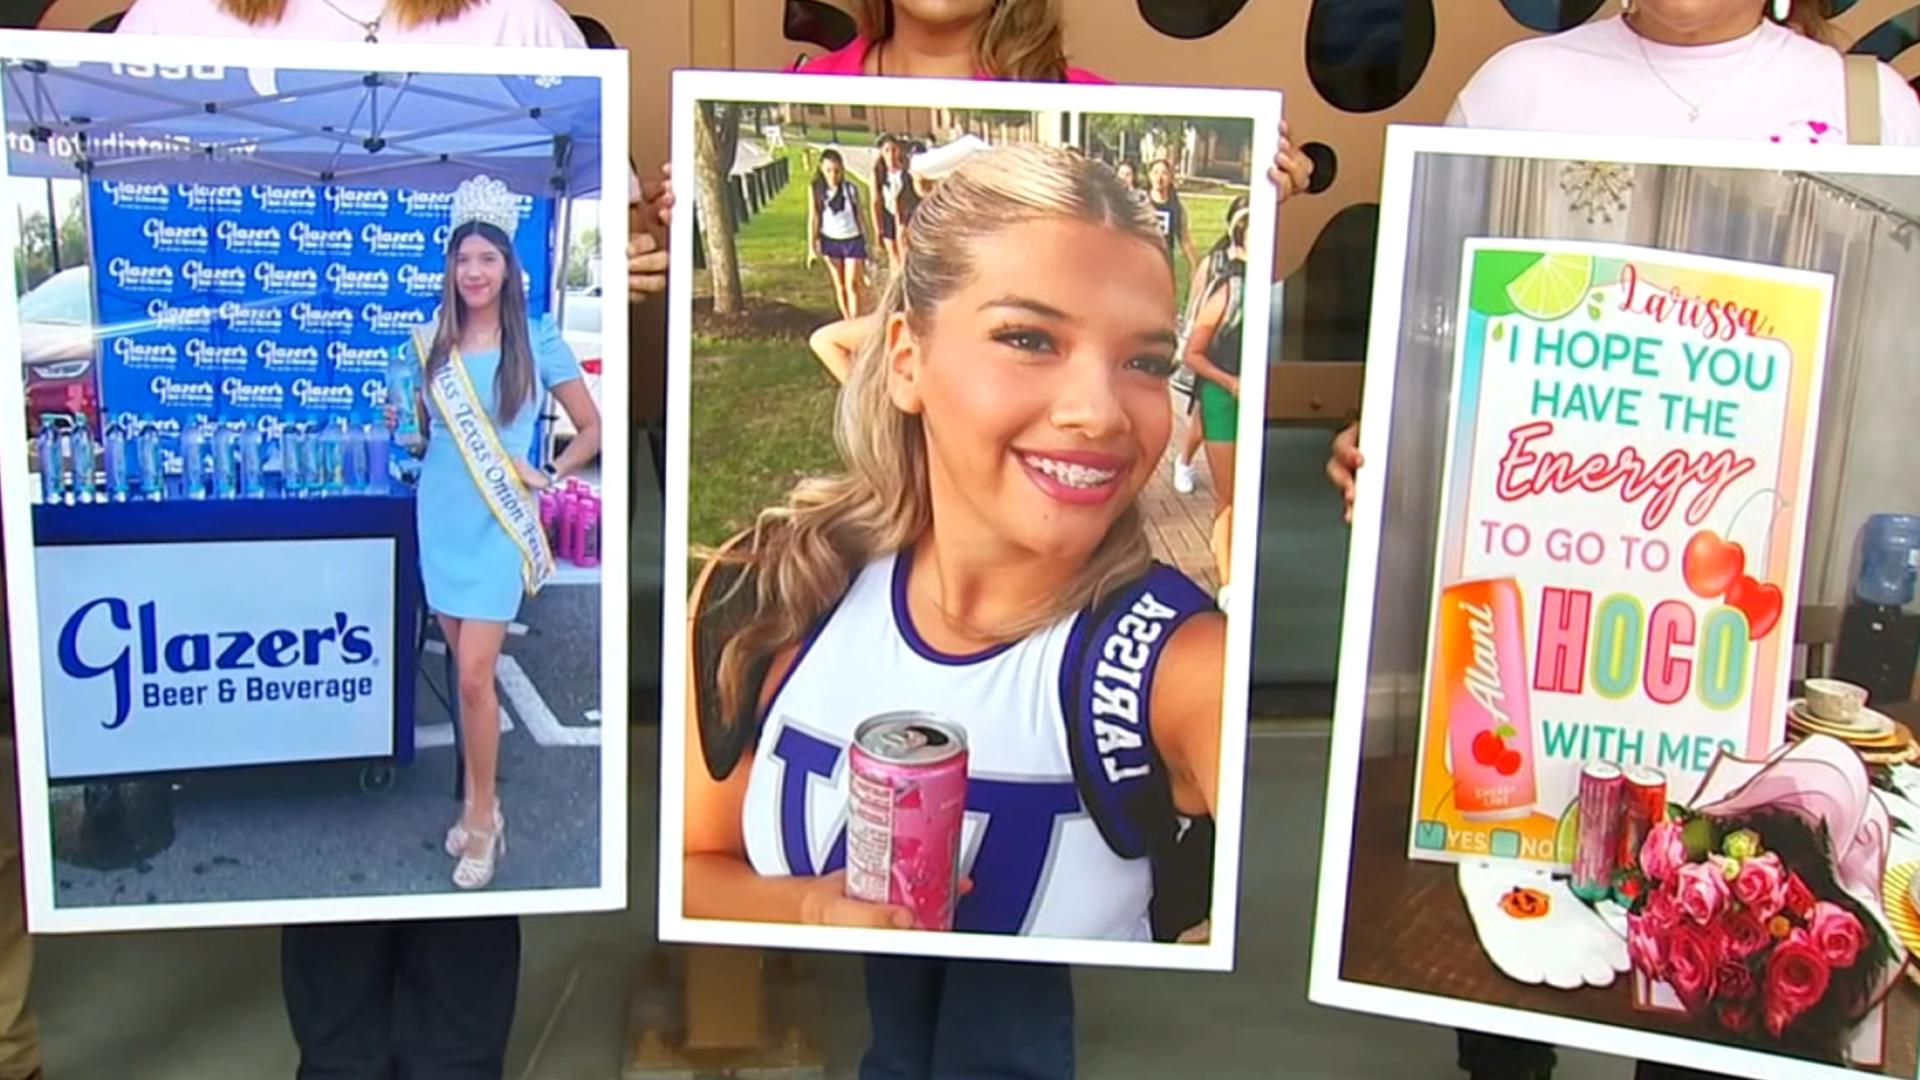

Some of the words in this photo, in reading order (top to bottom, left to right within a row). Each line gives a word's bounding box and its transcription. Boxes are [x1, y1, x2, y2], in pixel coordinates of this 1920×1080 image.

[1618, 263, 1775, 342] Larissa,
[1508, 324, 1520, 364] I
[1533, 326, 1663, 378] HOPE
[1681, 341, 1776, 392] YOU
[1530, 379, 1643, 427] HAVE
[1658, 392, 1740, 439] THE
[1496, 421, 1756, 531] Energy
[1480, 520, 1532, 557] TO
[1545, 528, 1606, 565] GO
[1620, 536, 1671, 573] TO
[57, 596, 374, 730] Glazer's
[1532, 586, 1751, 711] HOCO
[143, 682, 208, 708] Beer
[218, 678, 236, 703] &
[246, 676, 373, 703] Beverage
[1542, 719, 1644, 766] WITH
[1448, 829, 1489, 851] YES
[1521, 837, 1555, 858] NO
